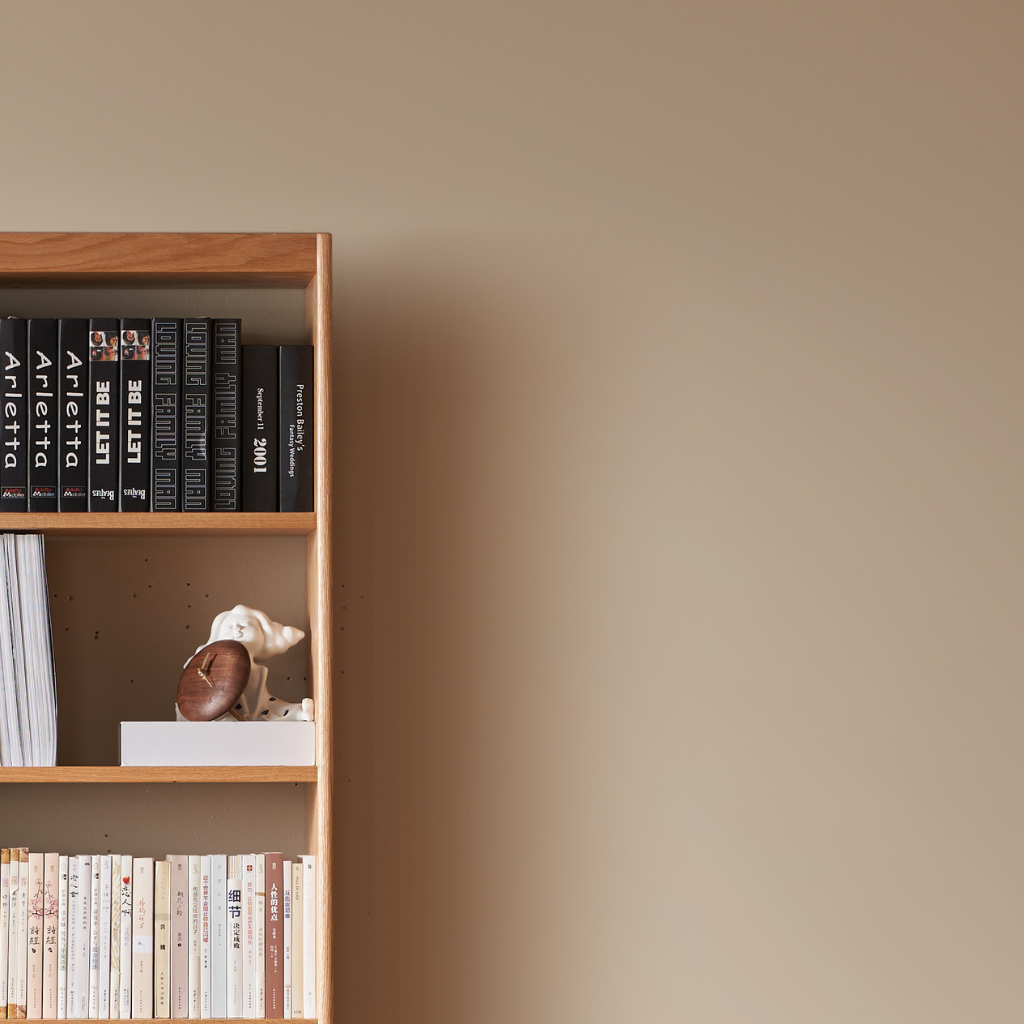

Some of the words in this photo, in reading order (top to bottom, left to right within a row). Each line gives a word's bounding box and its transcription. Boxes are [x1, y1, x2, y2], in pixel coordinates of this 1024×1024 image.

[215, 323, 236, 364] MAN
[96, 381, 110, 404] BE
[128, 380, 141, 403] BE
[215, 372, 236, 439] FAMILY
[256, 388, 264, 422] September
[295, 384, 305, 417] Preston
[4, 350, 22, 469] Arletta
[35, 350, 53, 469] Arletta
[65, 350, 83, 469] Arletta
[96, 408, 110, 426] IT
[128, 407, 141, 426] IT
[155, 394, 176, 461] FAMILY
[185, 394, 207, 461] FAMILY
[288, 424, 296, 447] Fantasy
[295, 419, 305, 451] Bailey's
[96, 430, 110, 465] LET
[128, 430, 141, 464] LET
[253, 438, 267, 474] 2001
[288, 448, 296, 477] Weddings
[155, 469, 176, 509] MAN
[185, 469, 207, 509] MAN
[228, 890, 242, 919] 细节
[270, 882, 278, 921] 人性的优点
[232, 922, 240, 950] 决定成败
